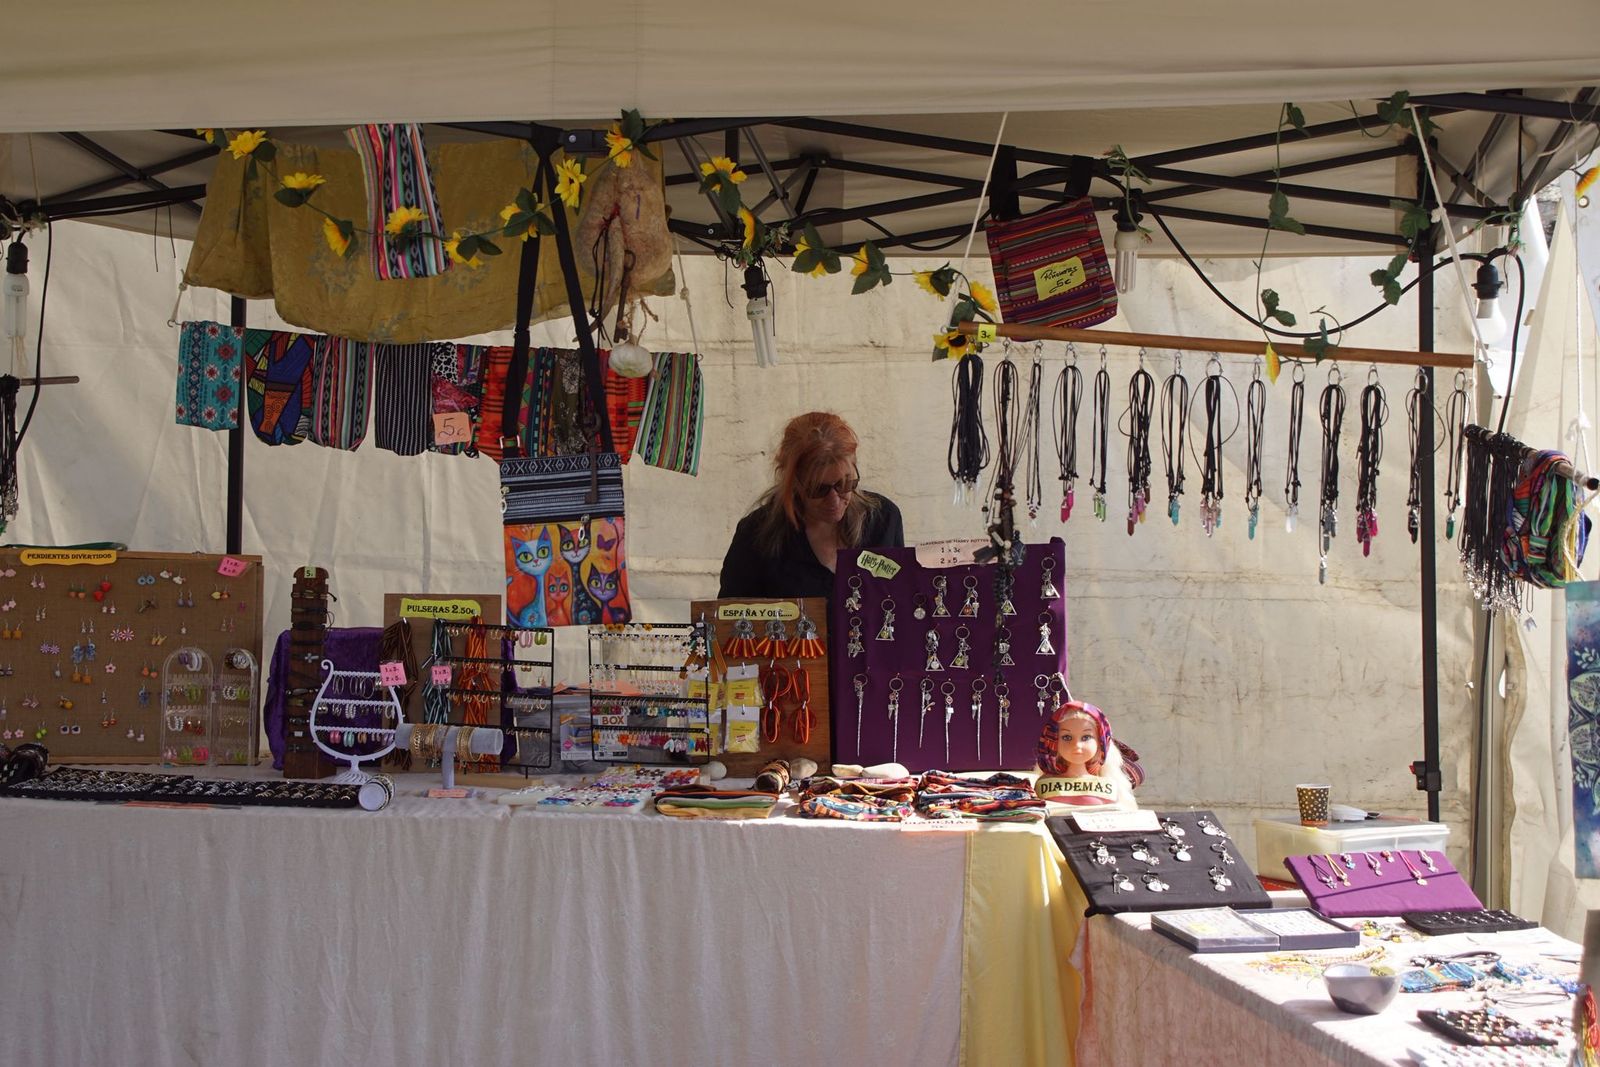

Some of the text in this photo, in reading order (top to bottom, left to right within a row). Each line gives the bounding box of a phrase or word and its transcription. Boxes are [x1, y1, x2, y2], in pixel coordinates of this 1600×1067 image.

[861, 554, 878, 568] Harry
[406, 605, 450, 614] PULSERAS
[760, 609, 767, 617] Y
[602, 716, 625, 724] BOX
[1041, 782, 1112, 794] DIADEMAS
